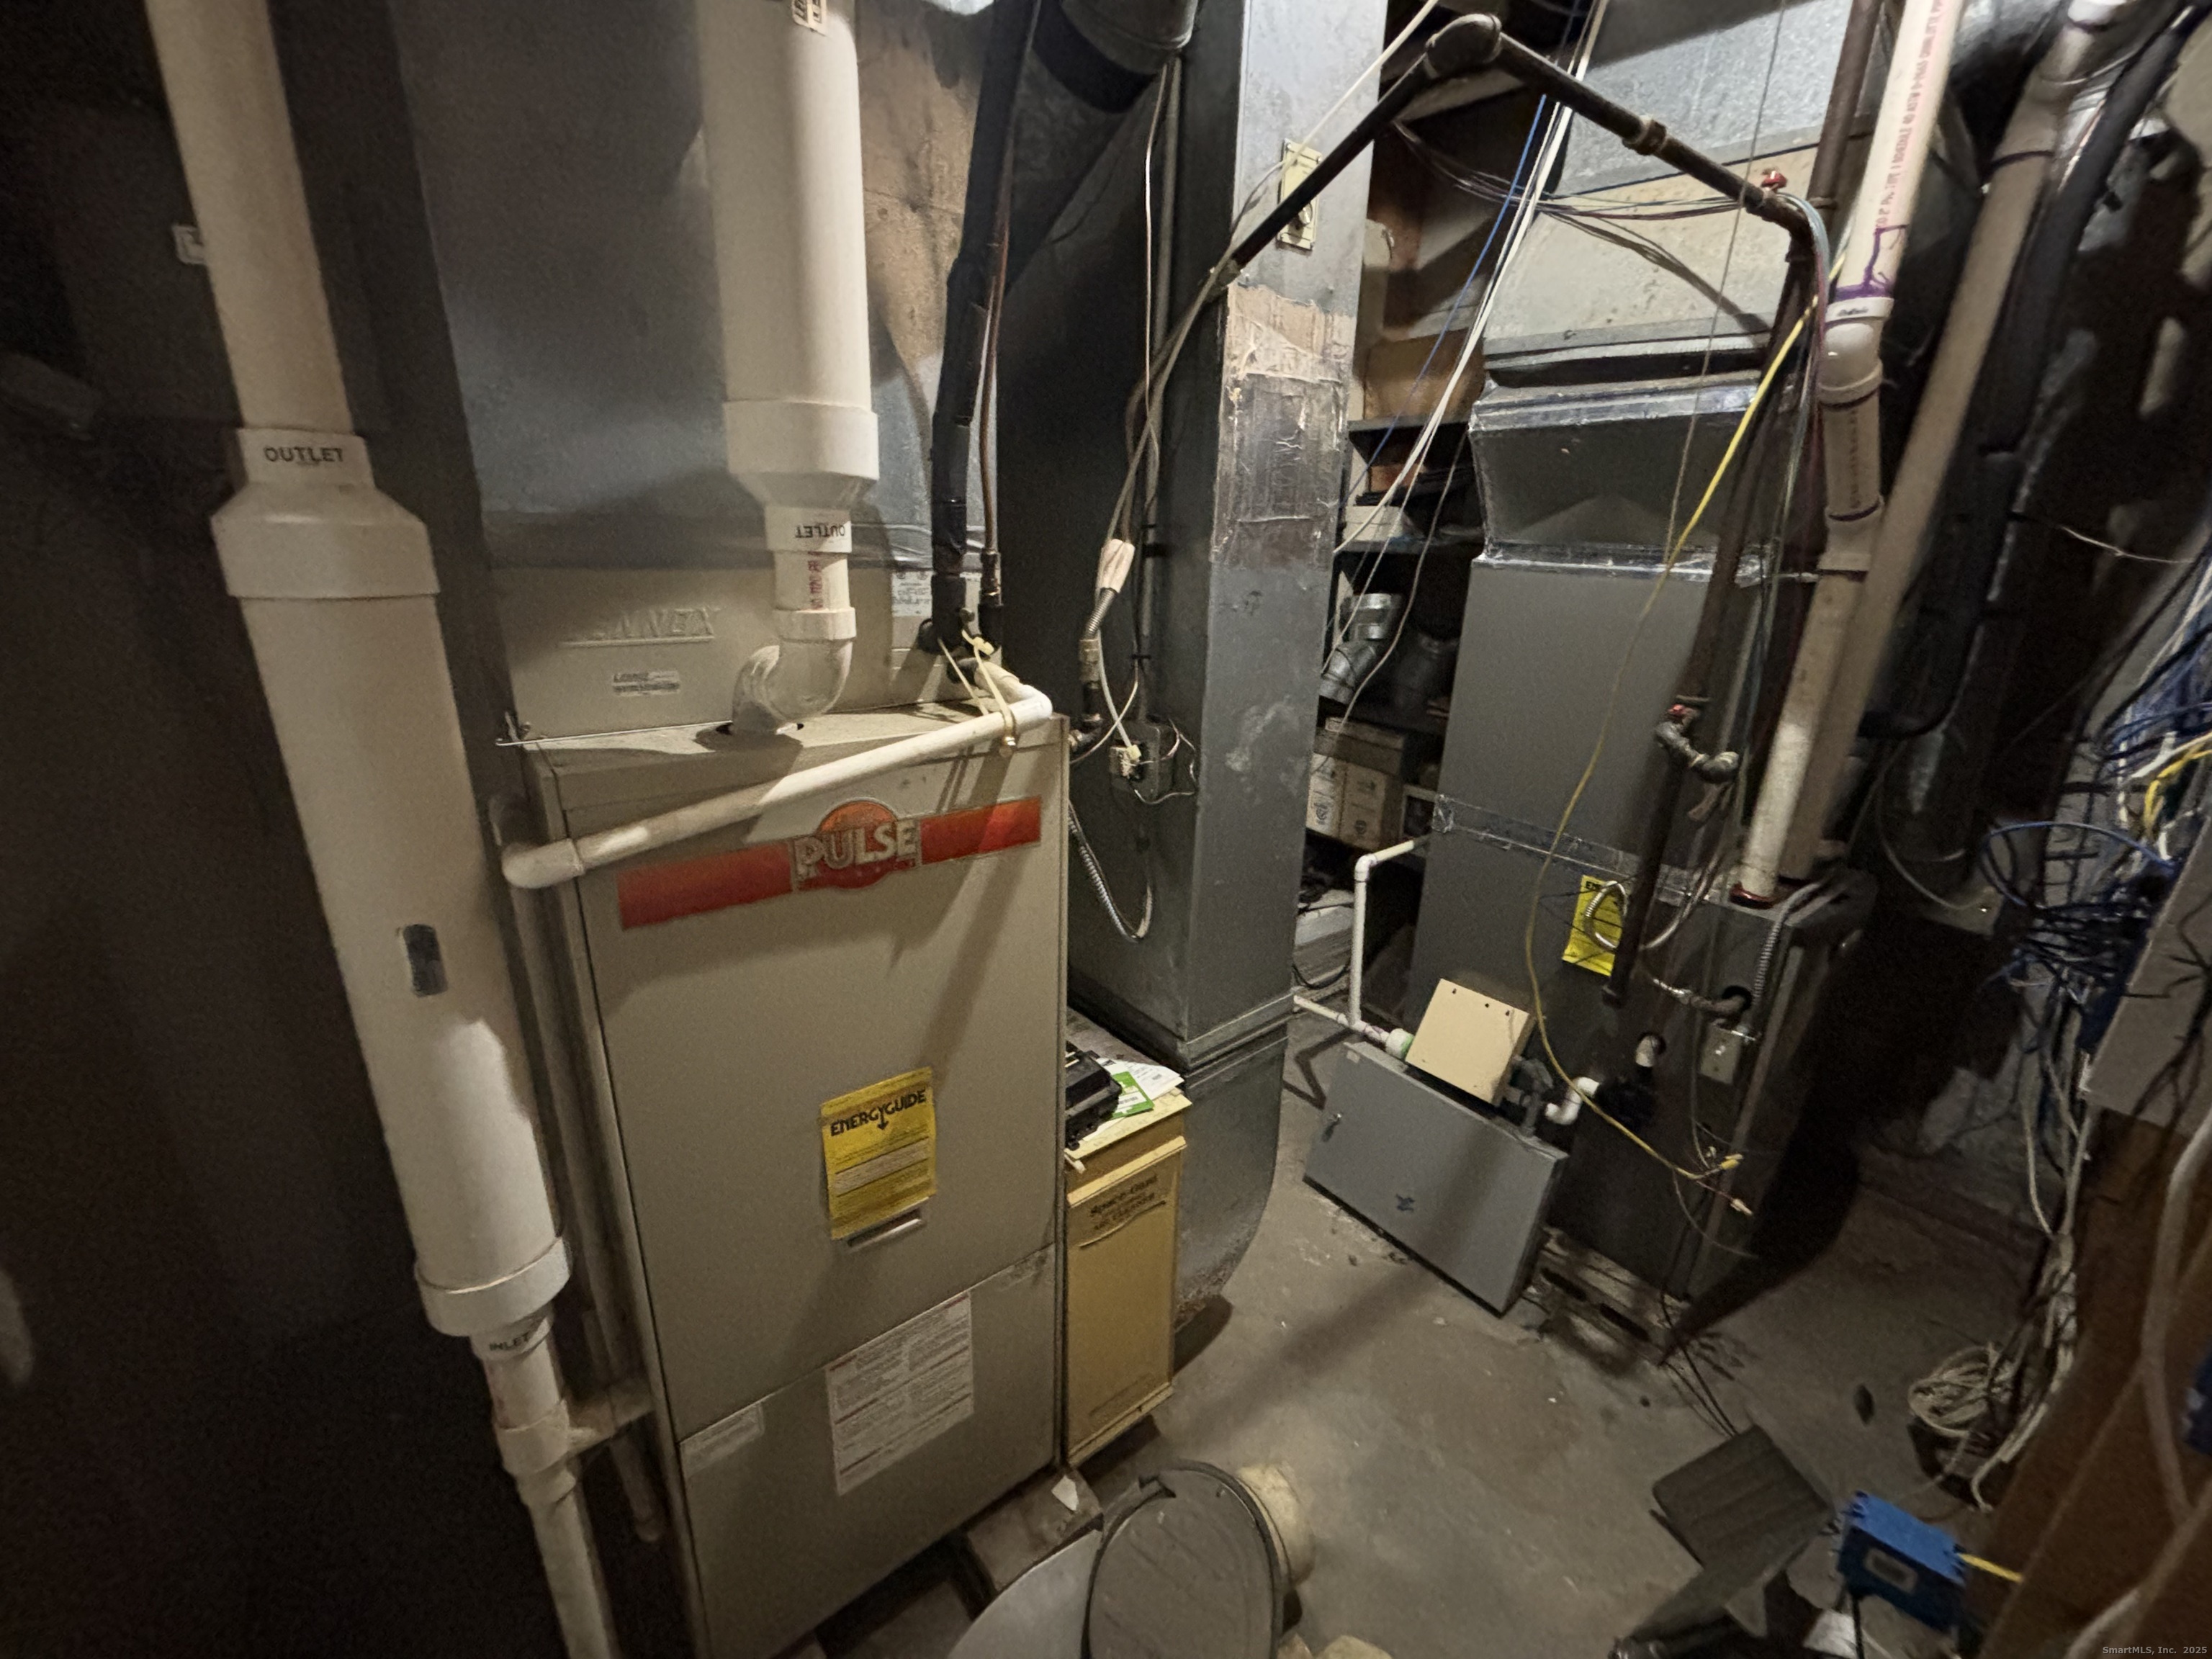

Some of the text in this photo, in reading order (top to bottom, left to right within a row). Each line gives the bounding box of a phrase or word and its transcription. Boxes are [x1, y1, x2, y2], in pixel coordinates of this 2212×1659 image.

[262, 445, 343, 462] OUTLET
[794, 523, 845, 539] OUTLET
[793, 818, 917, 882] PULSE
[830, 1086, 927, 1130] ENERGYGUIDE
[489, 1331, 531, 1351] INLET
